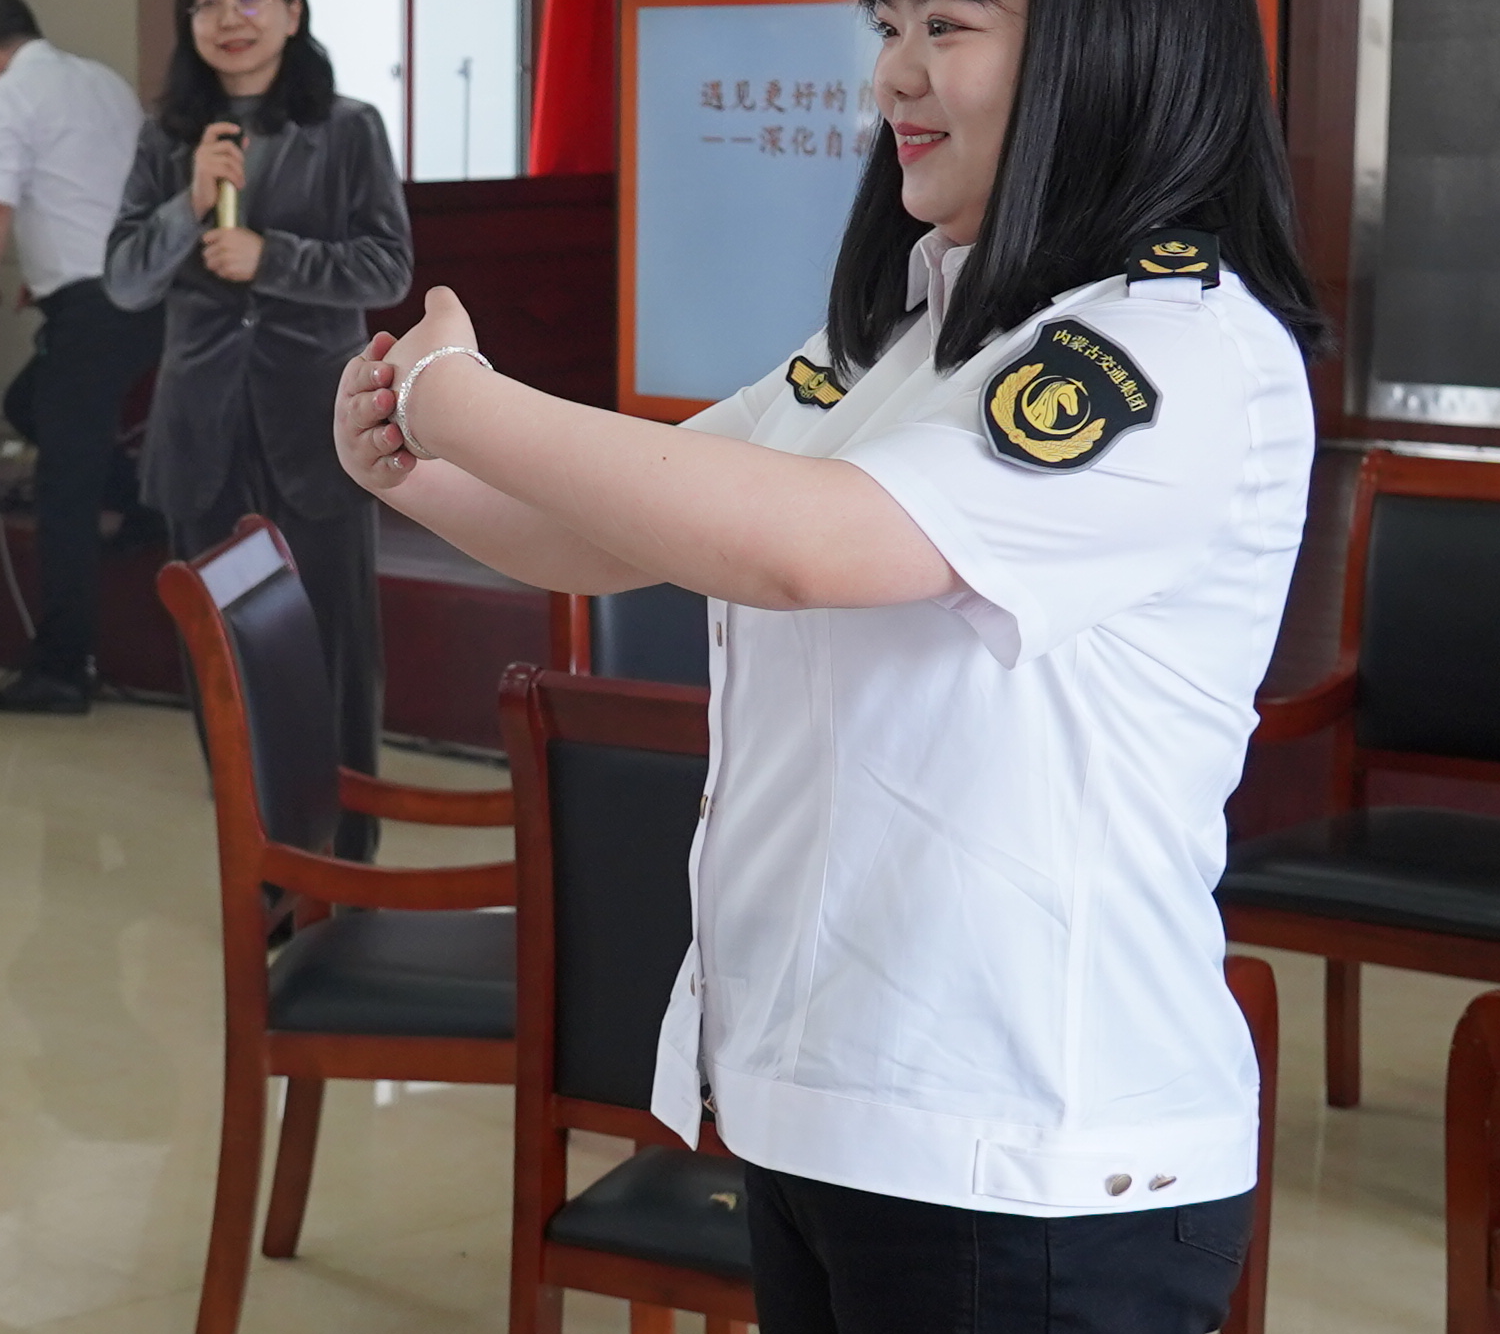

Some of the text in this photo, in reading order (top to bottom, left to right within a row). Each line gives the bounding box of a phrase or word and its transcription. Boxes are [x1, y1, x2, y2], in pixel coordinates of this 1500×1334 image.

[1053, 329, 1148, 412] 内蒙古交通集团
